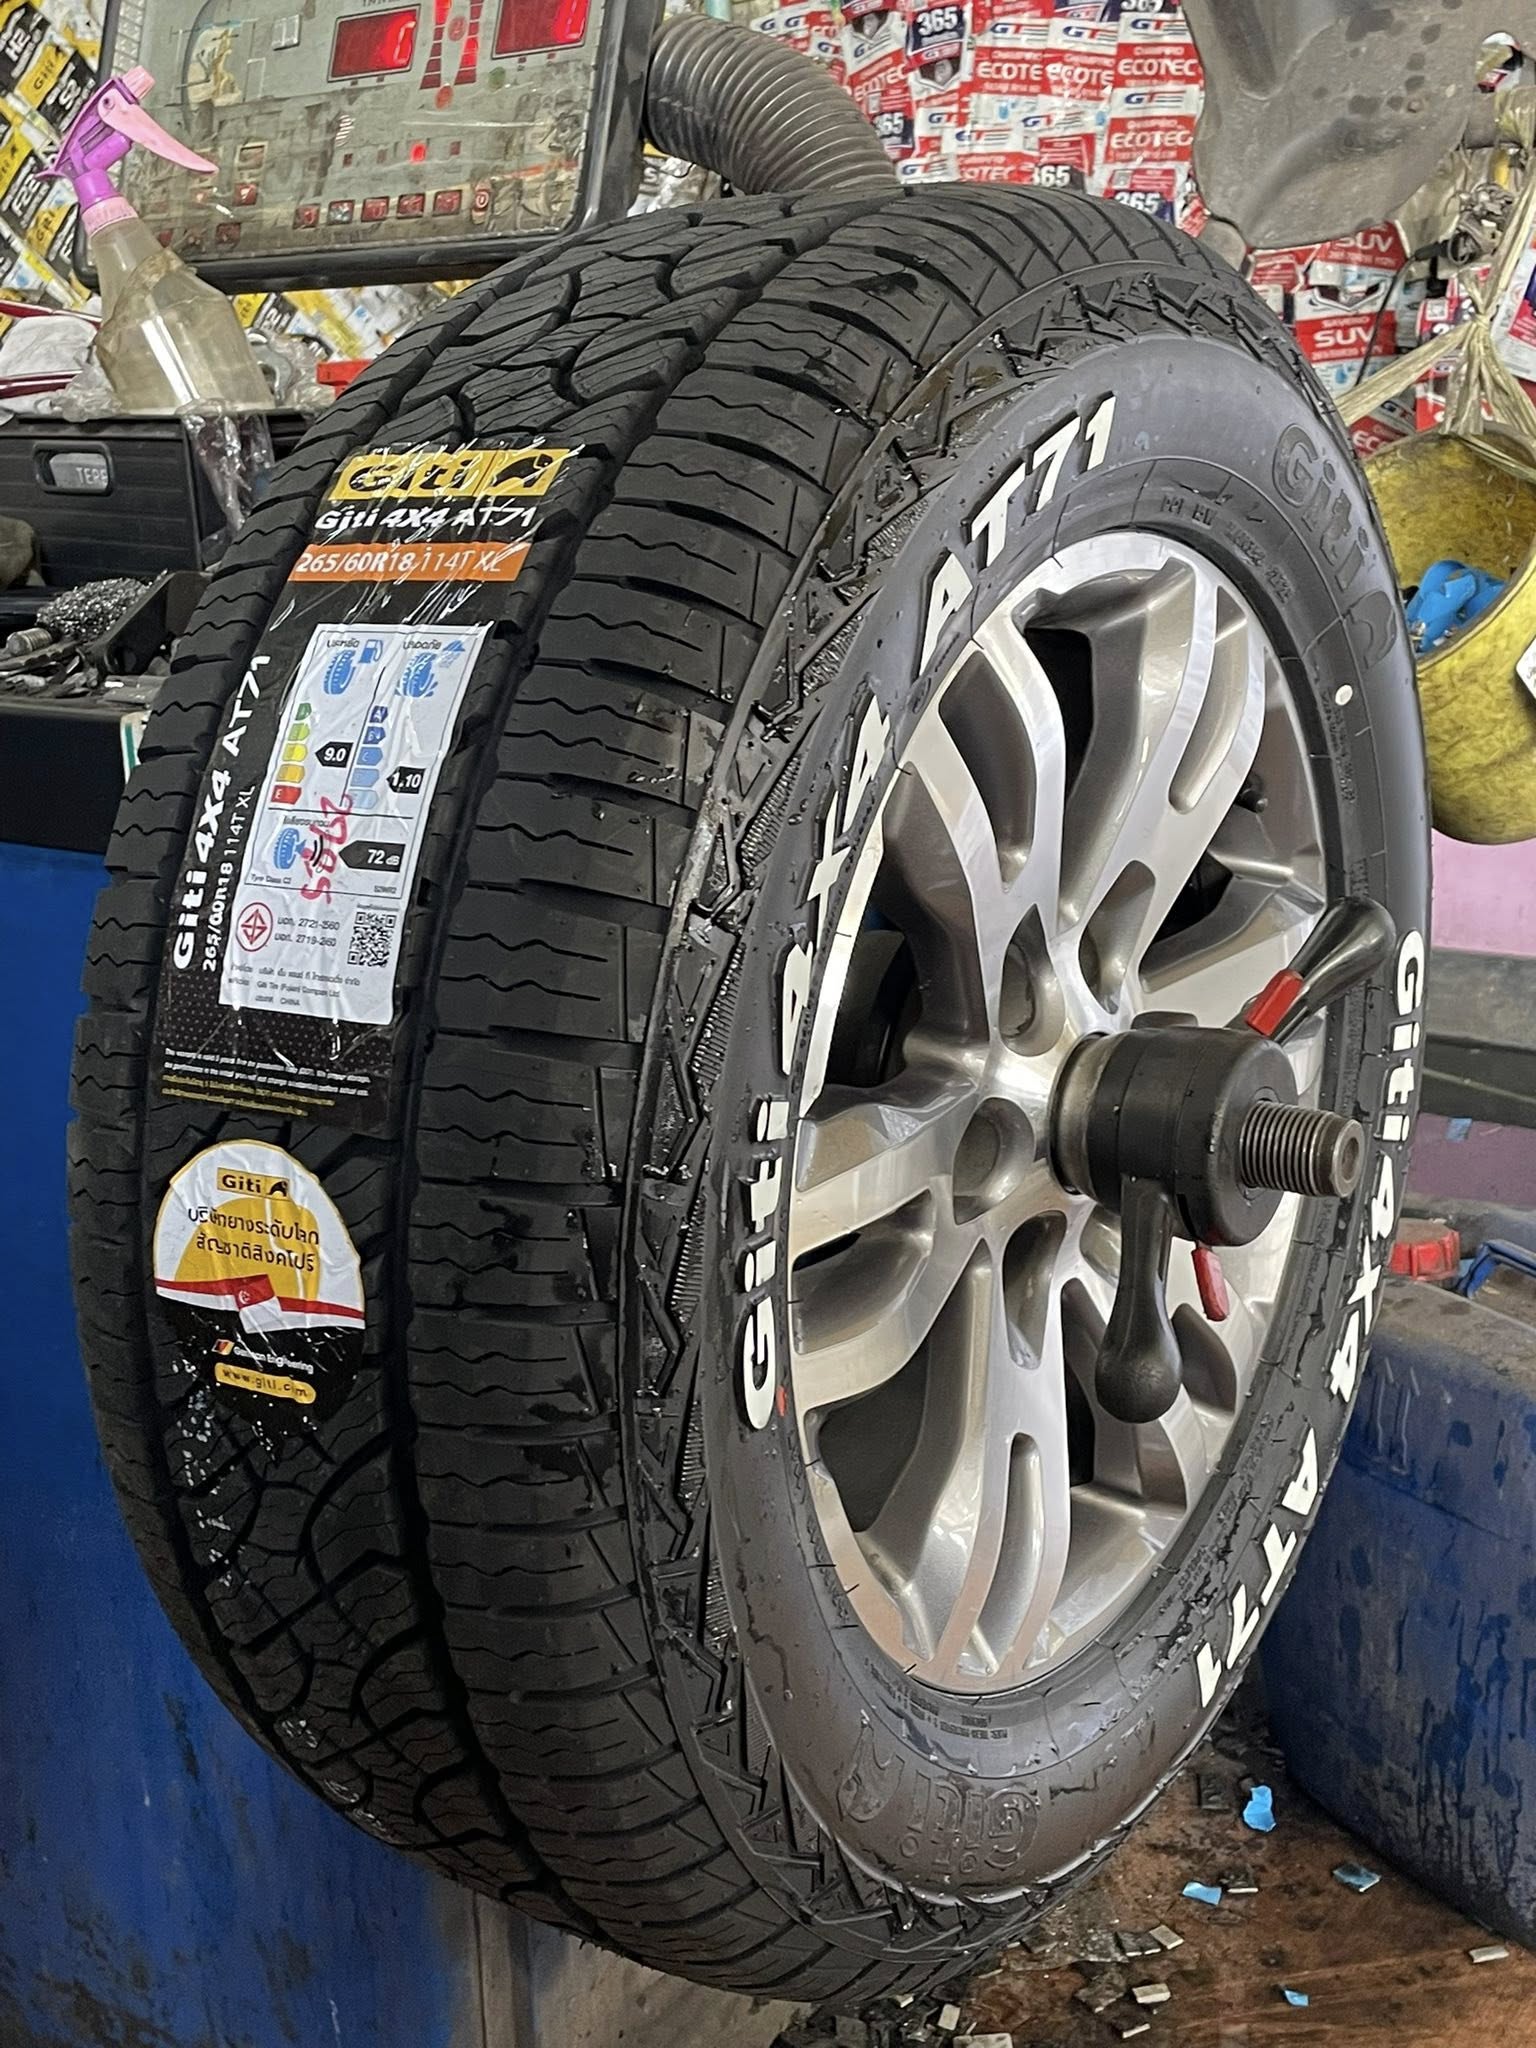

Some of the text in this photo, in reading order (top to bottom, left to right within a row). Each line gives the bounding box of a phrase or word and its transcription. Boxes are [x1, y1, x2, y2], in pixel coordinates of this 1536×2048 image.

[916, 6, 958, 36] 365
[1117, 58, 1199, 76] ECOTEC
[1110, 130, 1193, 148] ECOTEC
[1314, 326, 1374, 348] SUV
[349, 456, 476, 491] Giti
[314, 506, 537, 530] Giti 4X4 AT71
[296, 549, 502, 574] 265/60R18 114T XL
[323, 748, 346, 762] 9.0
[391, 773, 422, 789] 1.10
[173, 655, 271, 969] Giti 4X4 AT71
[223, 812, 247, 858] 114T
[236, 785, 256, 810] XL
[367, 849, 385, 864] 72
[743, 1100, 790, 1430] Giti
[918, 393, 1116, 677] AT71
[1382, 929, 1425, 1142] Giti
[221, 1174, 262, 1195] Giti
[188, 1206, 319, 1245] บริษัทยางระดับโลก
[196, 1232, 316, 1272] สัญชาติสิงคโปร์
[1329, 1153, 1395, 1403] 4X4
[222, 1369, 308, 1397] www.giti.cm
[1196, 1427, 1319, 1709] AT71
